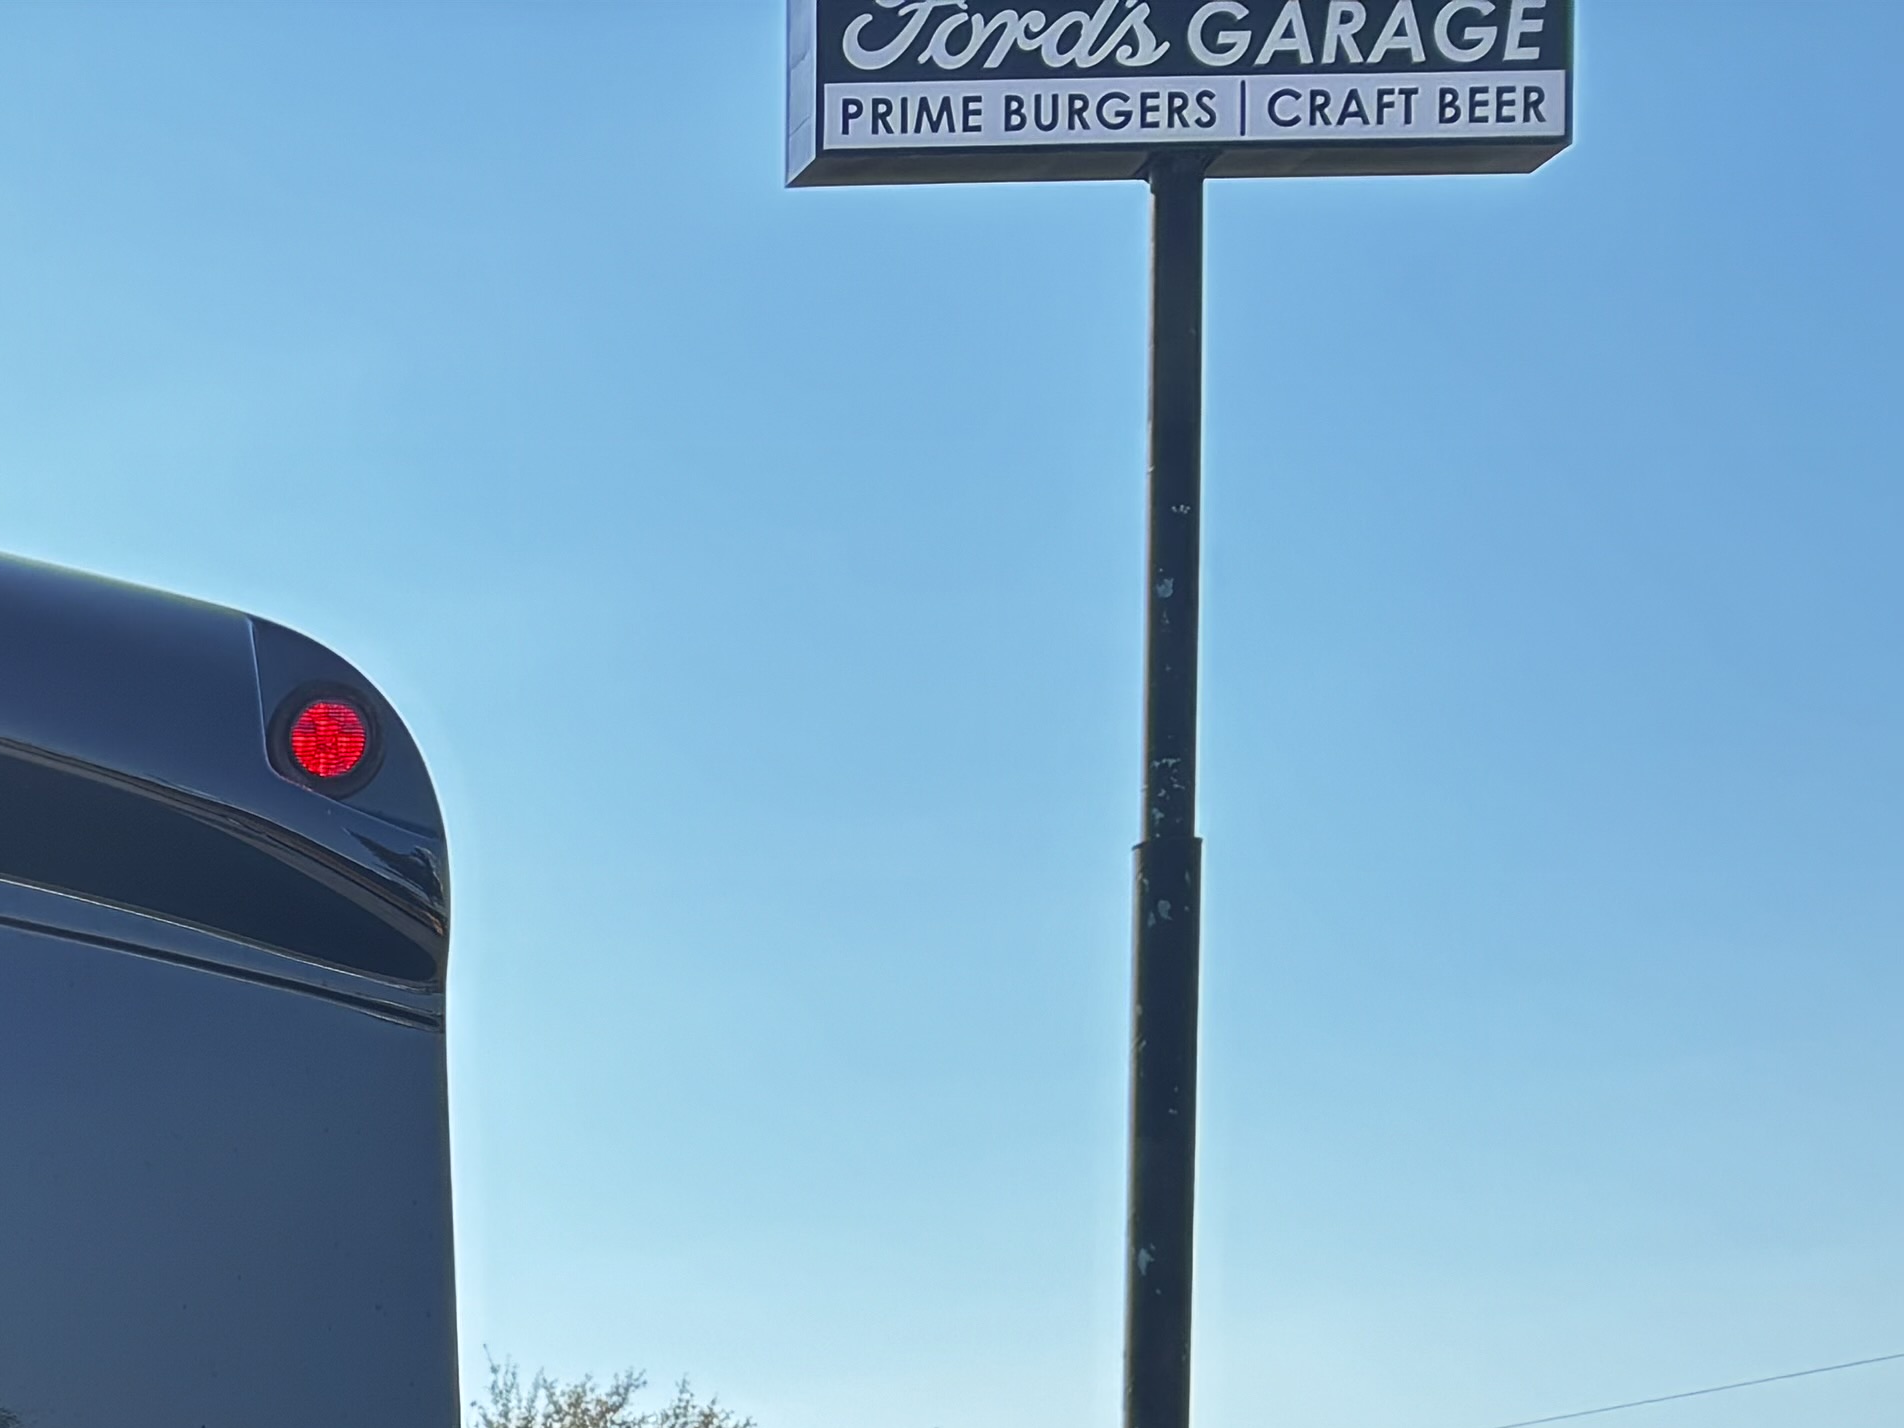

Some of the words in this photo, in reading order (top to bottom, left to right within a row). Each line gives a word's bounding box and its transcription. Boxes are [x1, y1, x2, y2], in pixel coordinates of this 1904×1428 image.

[1186, 0, 1547, 66] GARAGE
[839, 92, 984, 137] PRIME
[1003, 88, 1218, 133] BURGERS
[1266, 86, 1420, 128] CRAFT
[1437, 85, 1547, 125] BEER
